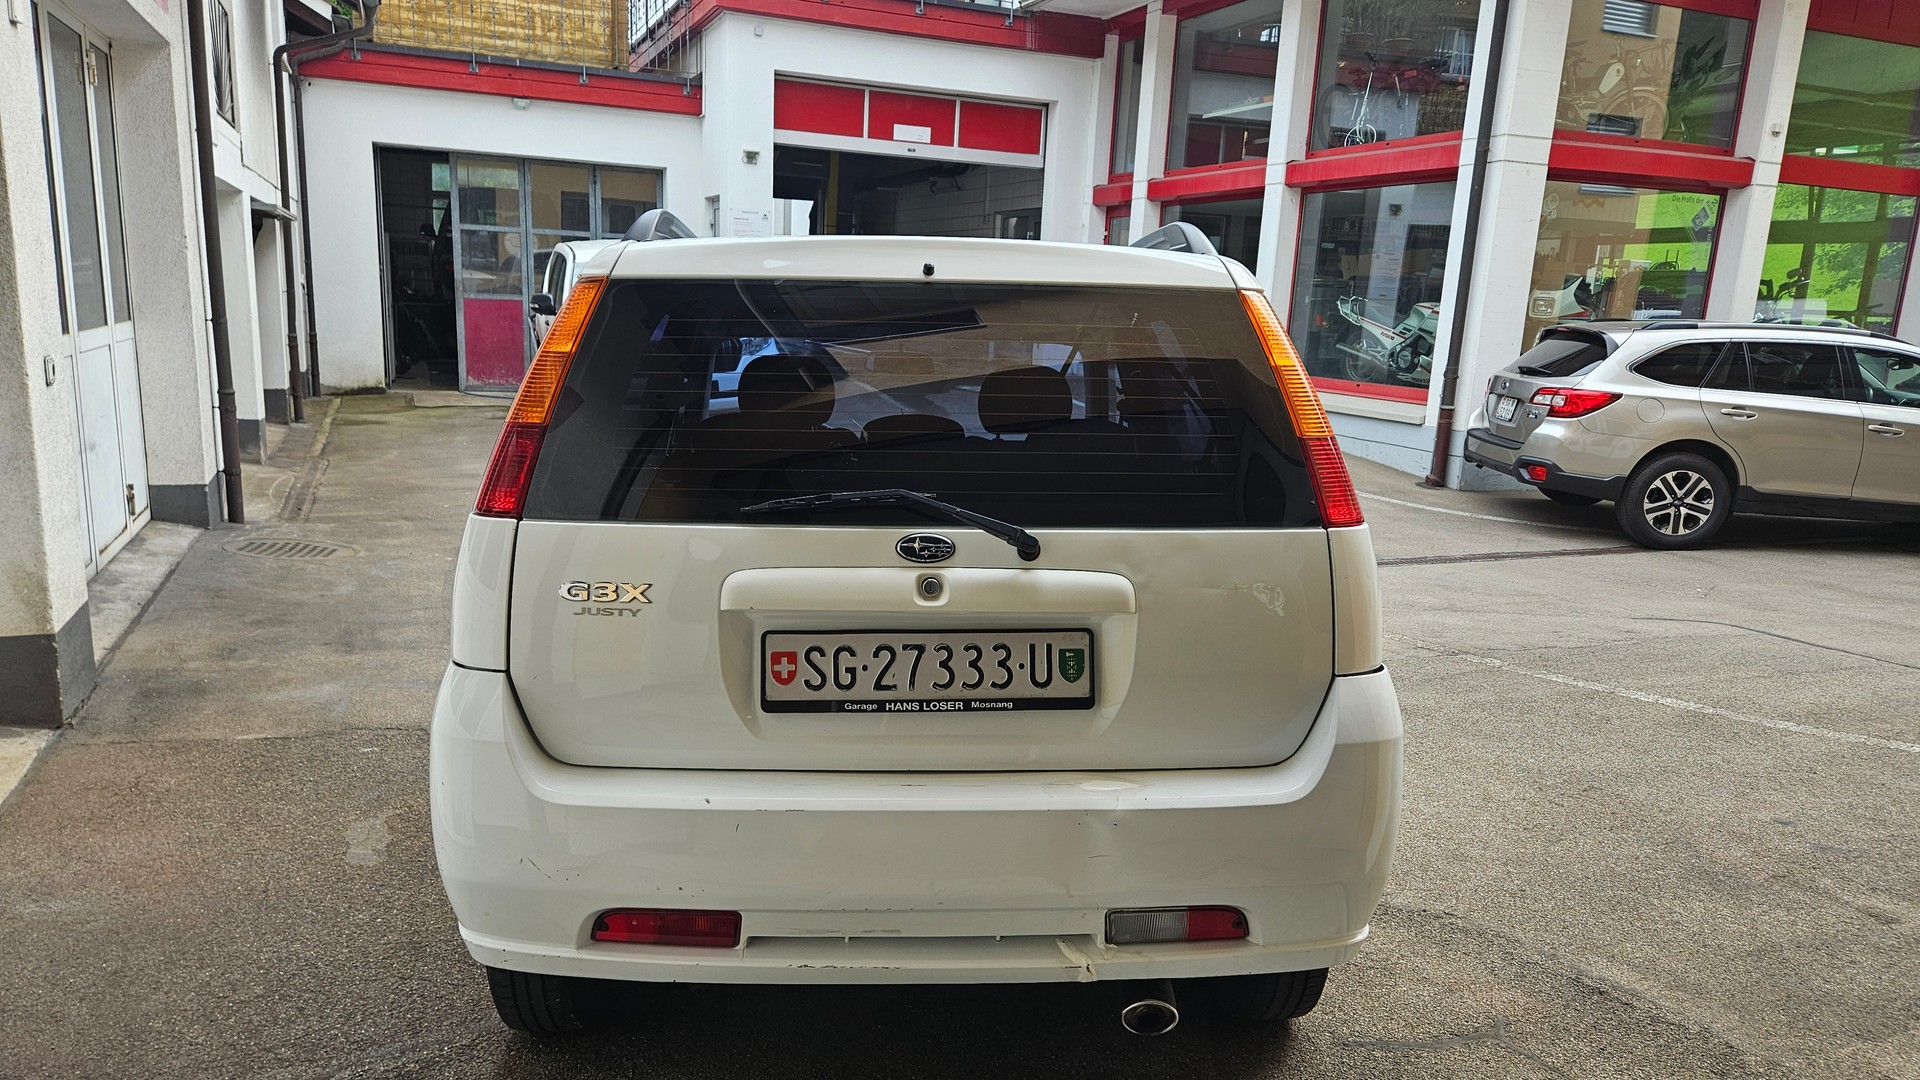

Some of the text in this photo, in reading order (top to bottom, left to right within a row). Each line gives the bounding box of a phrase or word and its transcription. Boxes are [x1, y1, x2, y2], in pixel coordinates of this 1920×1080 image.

[558, 581, 653, 604] G3X
[573, 607, 642, 617] JUSTY
[844, 701, 1013, 711] Garage HANS LOSER Mosnang
